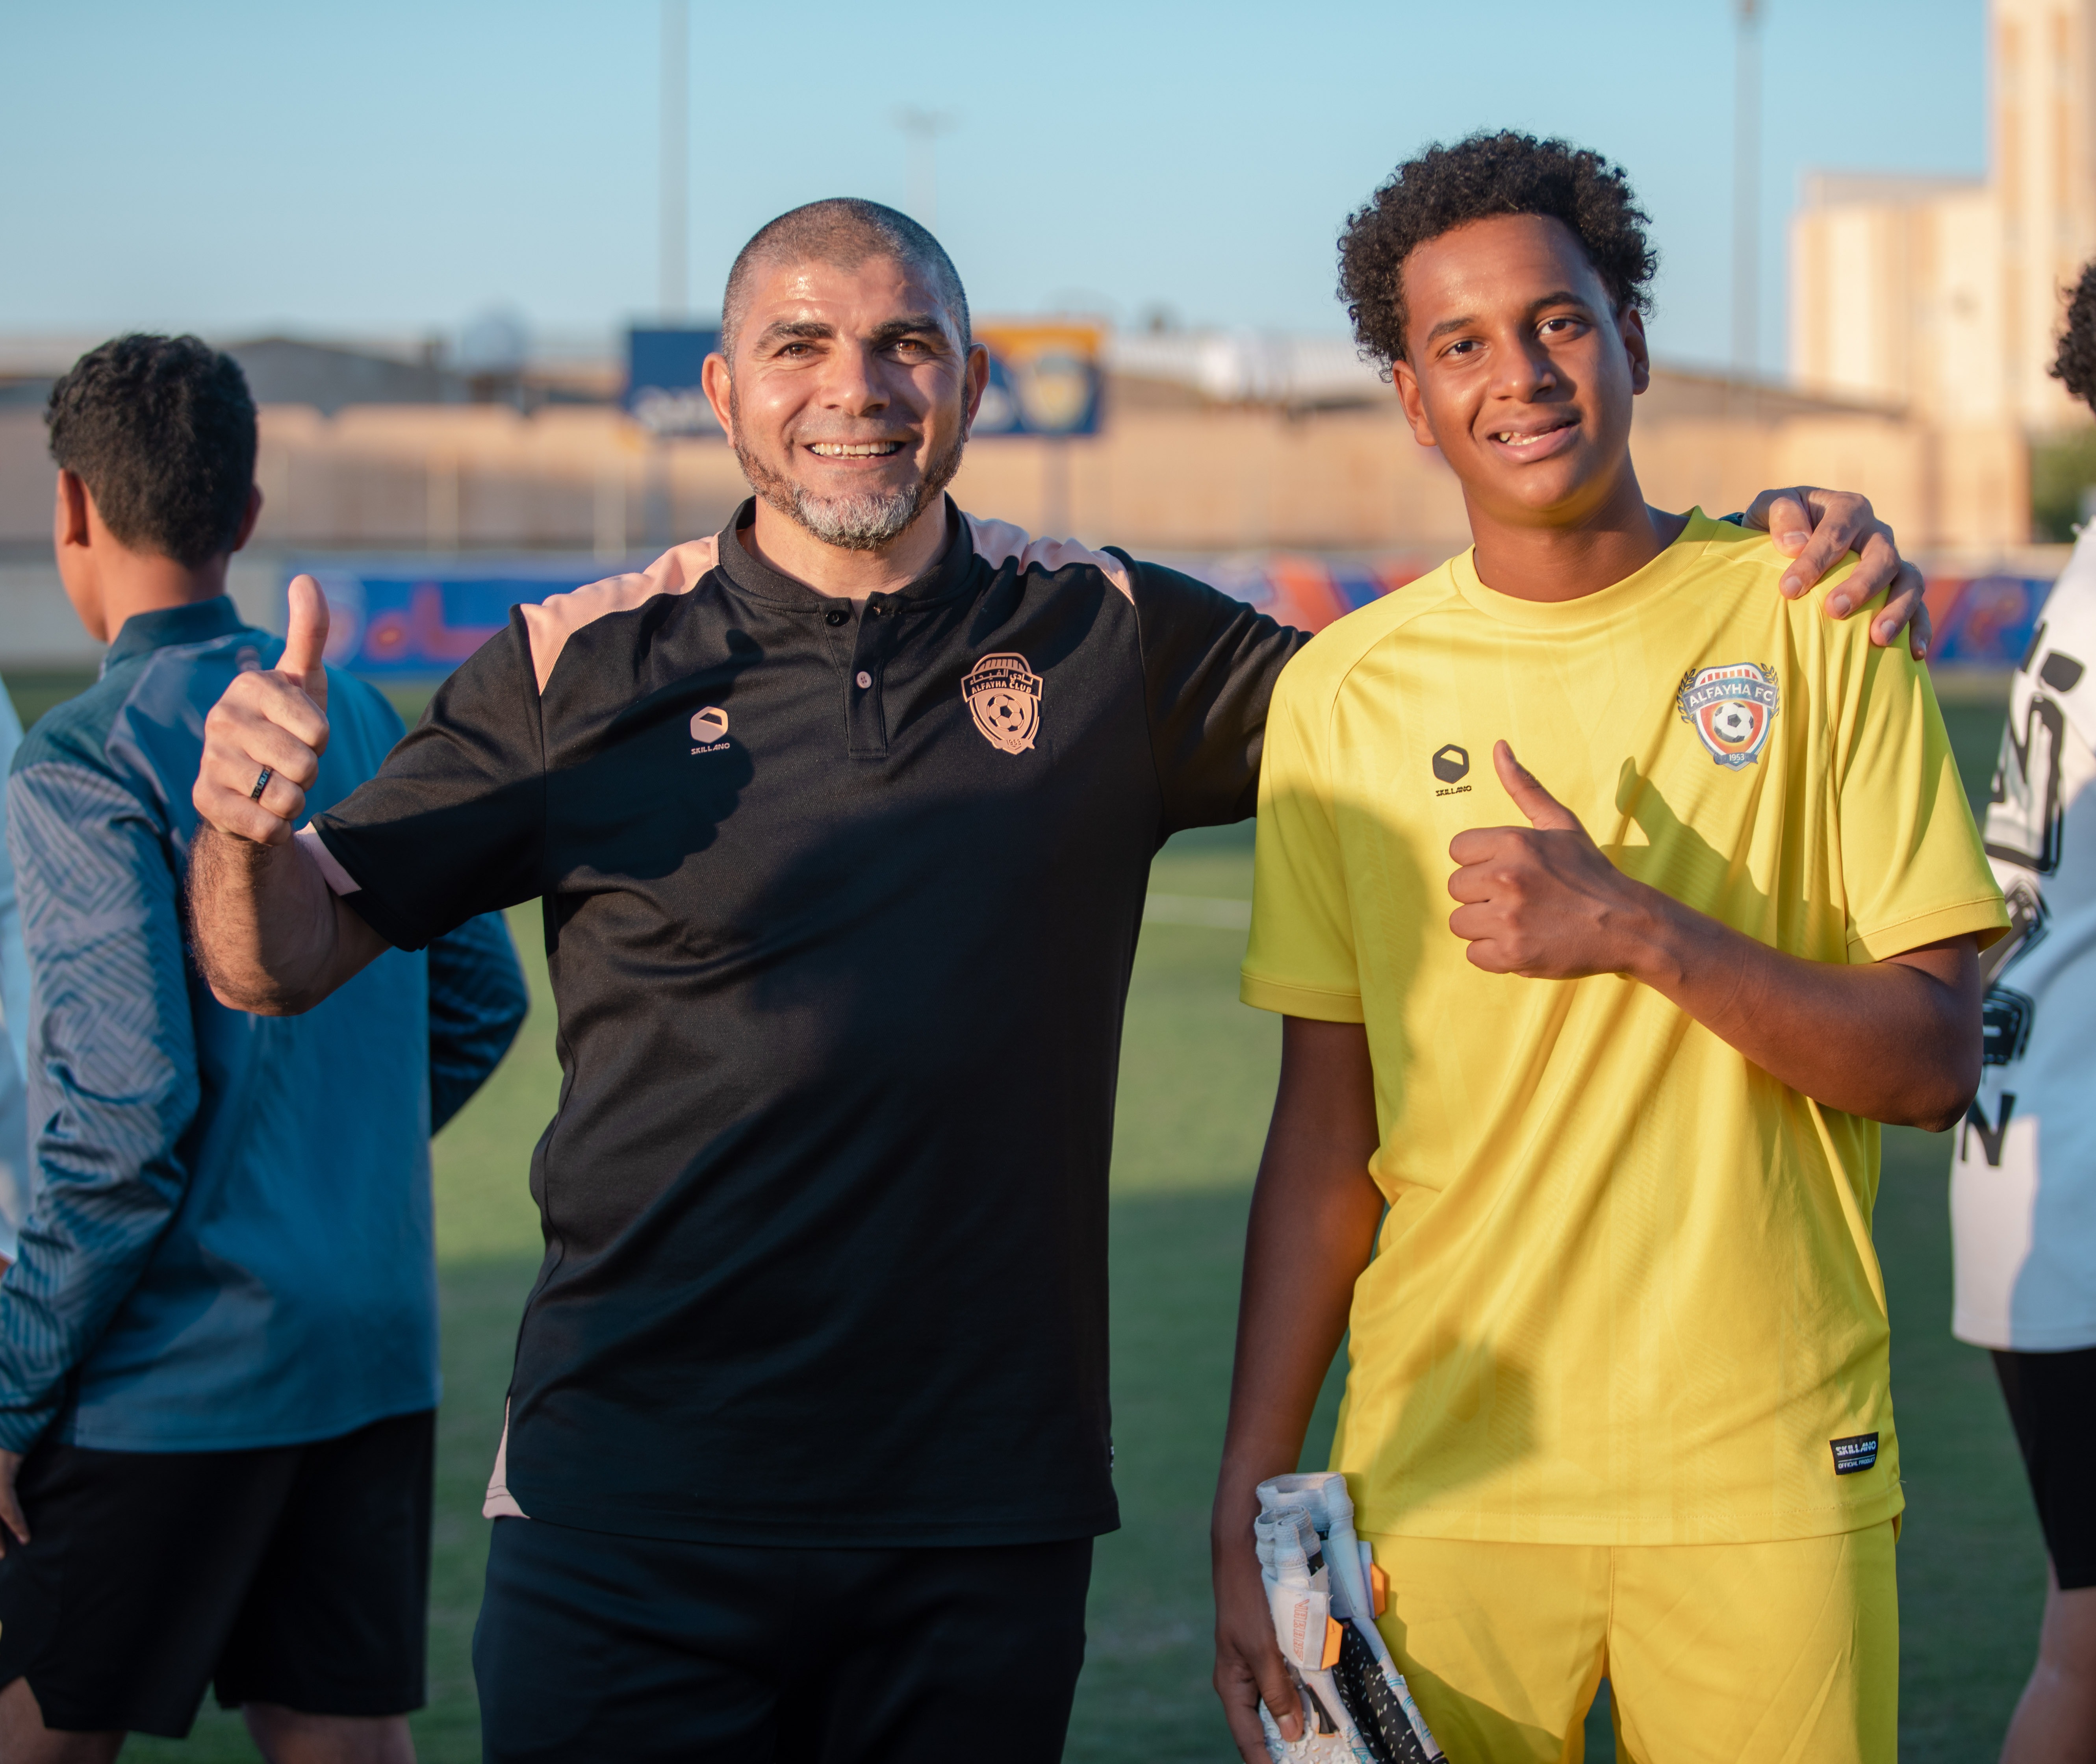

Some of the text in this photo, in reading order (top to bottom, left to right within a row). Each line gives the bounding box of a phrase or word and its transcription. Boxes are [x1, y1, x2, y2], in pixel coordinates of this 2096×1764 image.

[971, 680, 1032, 694] ALFAYHA CLUB
[1690, 683, 1773, 707] ALFAYHA FC
[691, 743, 730, 755] SKILLANO
[1436, 785, 1472, 797] SKILLANO
[1835, 1440, 1876, 1456] SKILLANO
[1838, 1456, 1876, 1469] OFFICIAL PRODUCT
